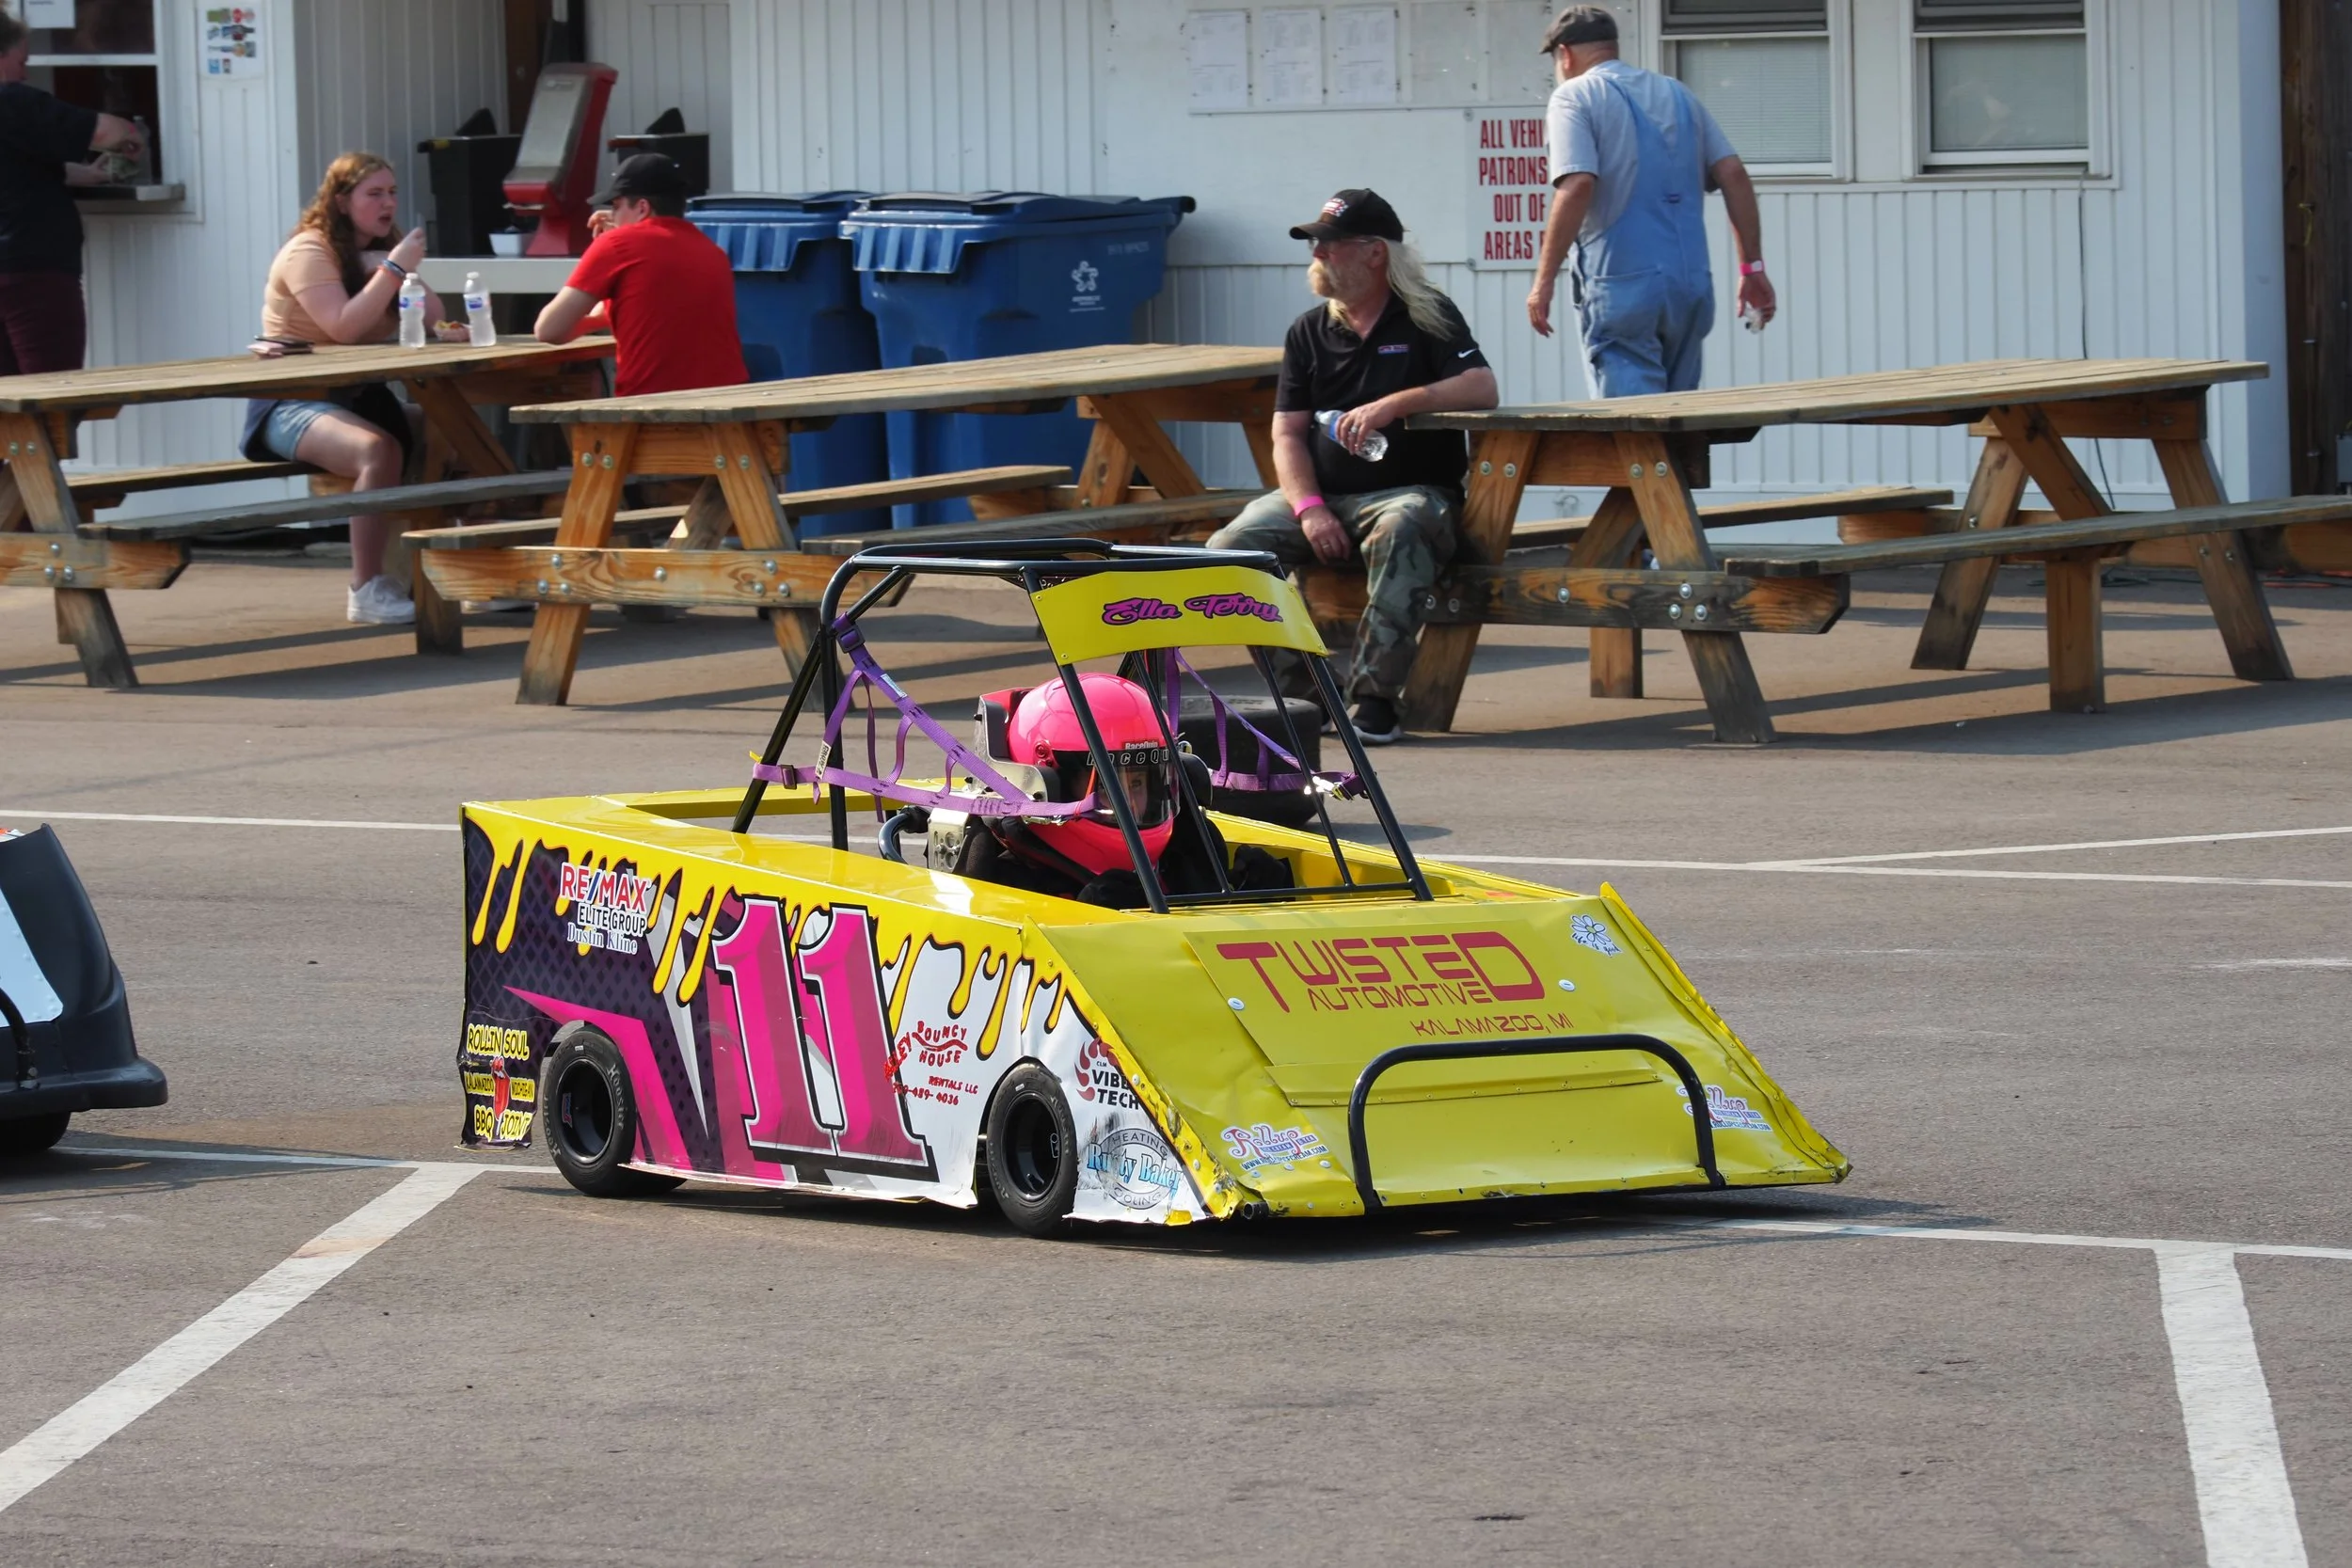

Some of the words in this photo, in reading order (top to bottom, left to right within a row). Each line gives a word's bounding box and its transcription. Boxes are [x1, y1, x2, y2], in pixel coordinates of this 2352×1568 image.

[1480, 119, 1504, 149] ALL
[1509, 119, 1544, 148] VEHI
[1479, 156, 1548, 185] PATRONS
[1494, 194, 1522, 222] OUT
[1528, 193, 1547, 222] OF
[1485, 230, 1534, 260] AREAS
[1102, 597, 1183, 626] Ella
[1184, 593, 1283, 622] Terry
[562, 864, 647, 912] RE/MAX
[579, 905, 609, 927] ELITE
[611, 911, 646, 935] GROUP
[567, 923, 604, 948] Dustin
[607, 929, 638, 954] Kline
[1216, 931, 1545, 1013] TWISTED
[1308, 981, 1491, 1012] AUTOMOTIVE
[709, 895, 935, 1177] 11
[1548, 1013, 1574, 1029] MI
[468, 1025, 502, 1053] ROLLIN
[503, 1033, 529, 1056] SOUL
[919, 1051, 961, 1067] HOUSE
[607, 1063, 625, 1131] Hoosier
[929, 1075, 962, 1091] RENTALS
[965, 1083, 978, 1094] LLC
[1097, 1088, 1139, 1110] TECH
[475, 1109, 494, 1139] BBQ
[1111, 1132, 1168, 1158] HEATING
[1087, 1142, 1137, 1184] Ruty
[1137, 1152, 1184, 1191] Baker
